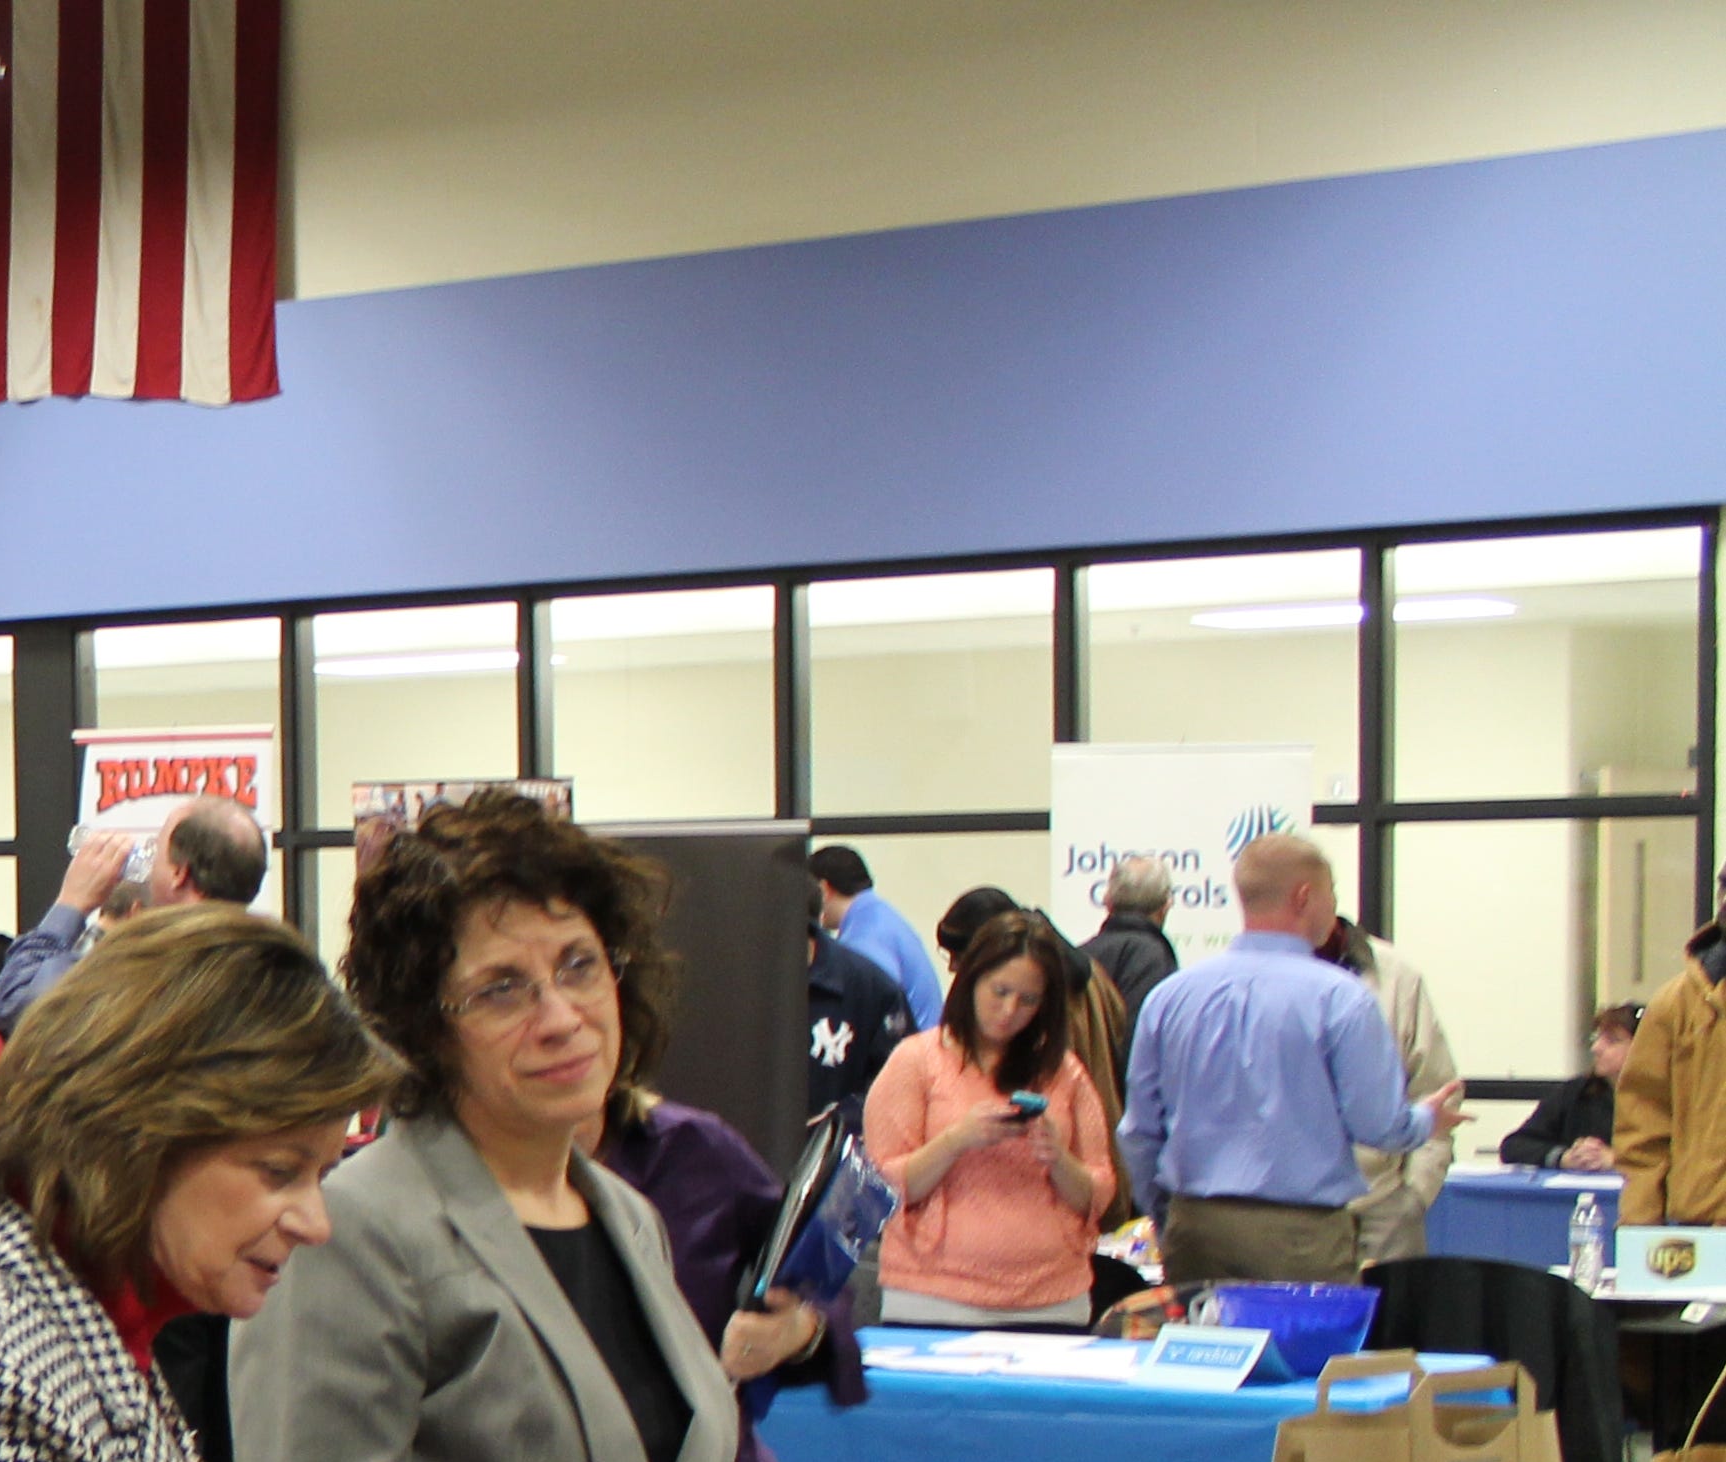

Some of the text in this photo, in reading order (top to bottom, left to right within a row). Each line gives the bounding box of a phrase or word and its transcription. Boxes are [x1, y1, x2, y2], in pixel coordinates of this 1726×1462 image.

[96, 755, 258, 813] RUMPKE
[1064, 842, 1200, 877] Johon
[1089, 878, 1229, 909] Crols
[810, 1017, 855, 1068] NY
